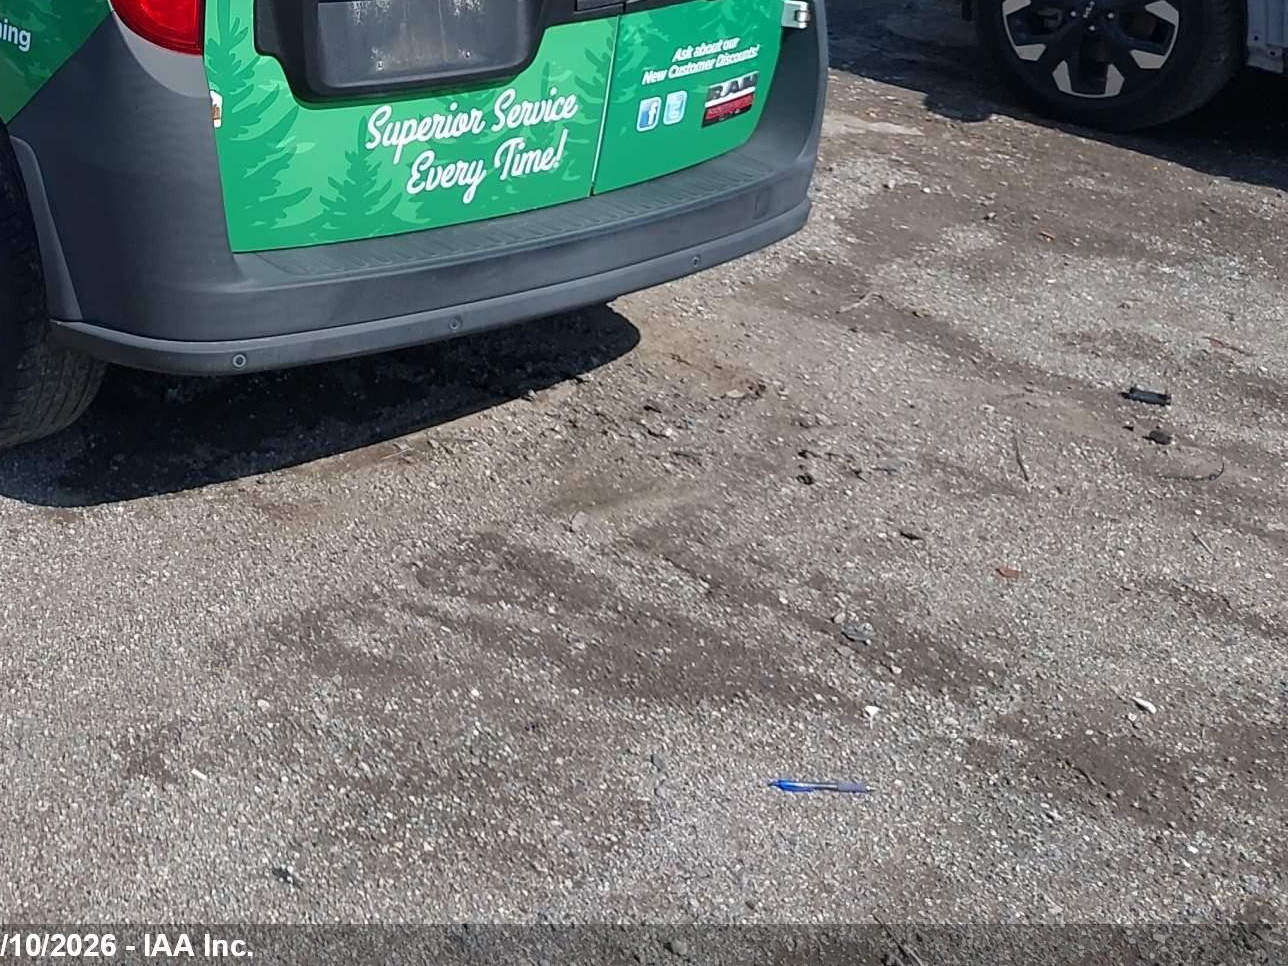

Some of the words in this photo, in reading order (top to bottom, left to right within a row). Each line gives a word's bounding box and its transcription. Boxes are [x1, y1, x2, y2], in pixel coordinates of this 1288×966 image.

[641, 69, 668, 85] New
[671, 45, 693, 62] Ask
[365, 104, 486, 165] Superior
[491, 87, 579, 132] Service
[406, 150, 487, 205] Every
[494, 128, 569, 181] Time!
